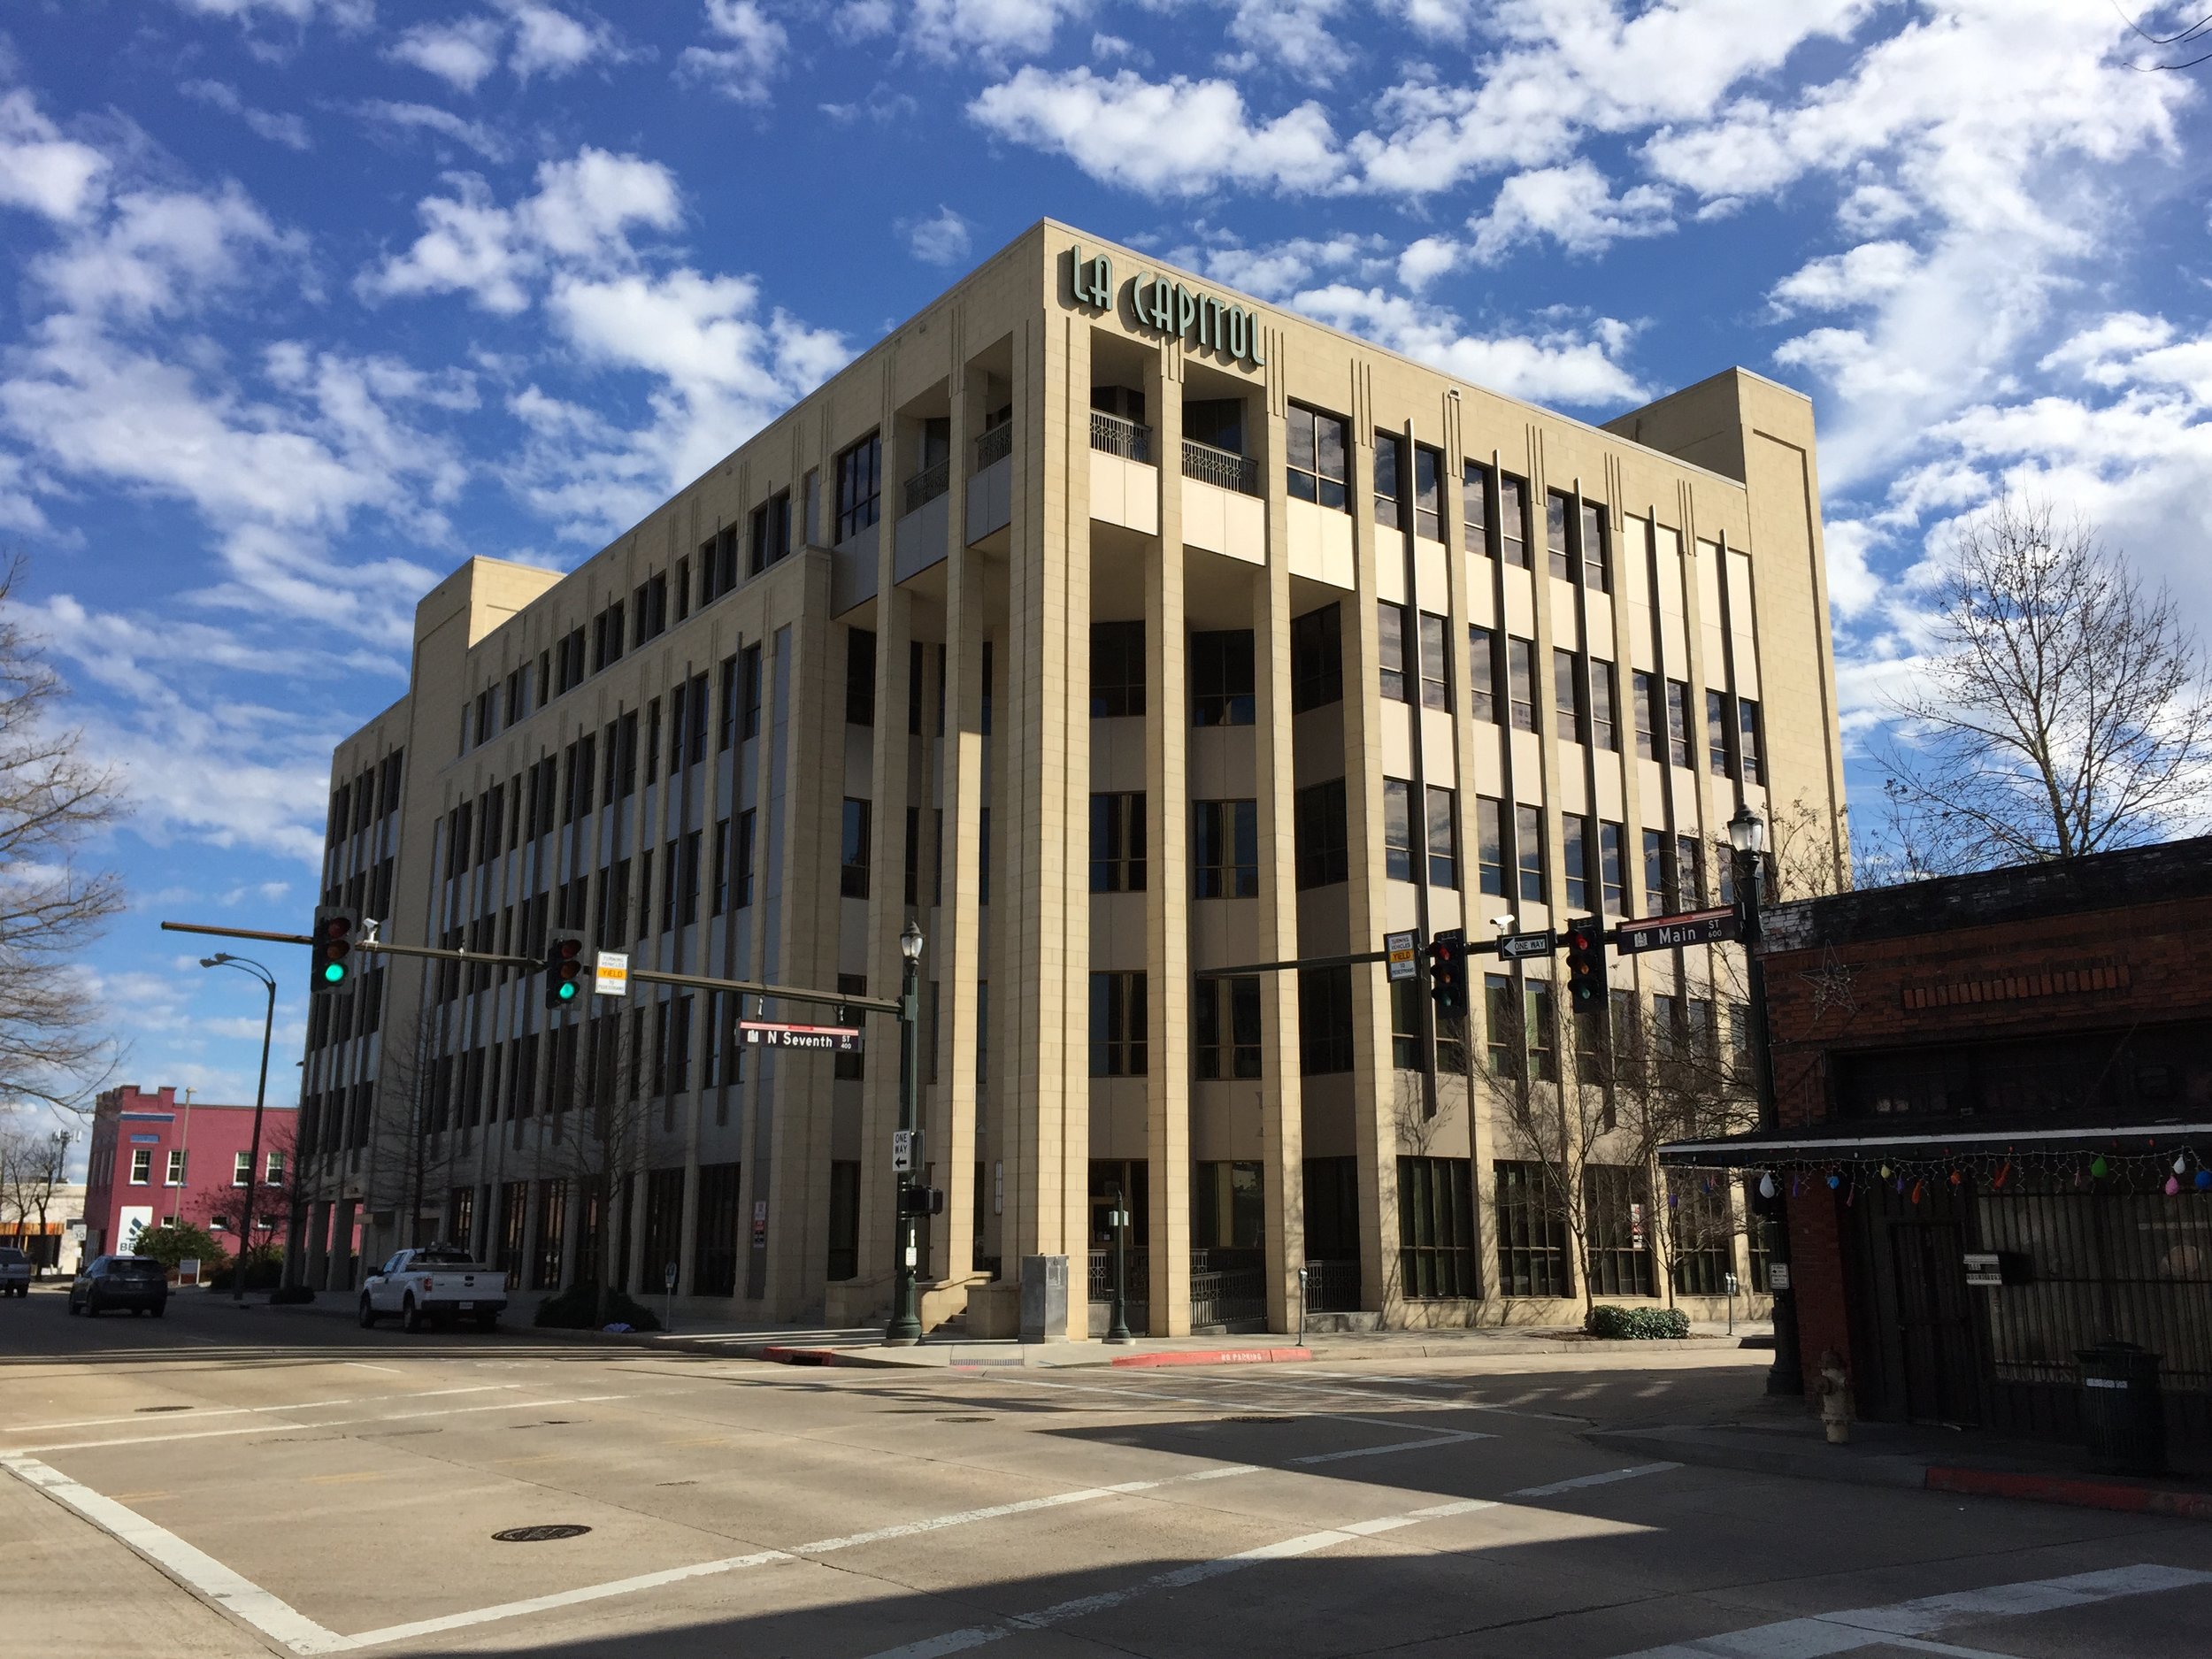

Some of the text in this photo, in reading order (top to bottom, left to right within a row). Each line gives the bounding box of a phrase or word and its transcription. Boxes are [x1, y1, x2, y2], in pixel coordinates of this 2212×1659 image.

[1072, 244, 1265, 366] LA CAPITOL
[1709, 919, 1719, 929] ST
[1658, 927, 1696, 944] Main
[1708, 930, 1722, 939] 600
[1514, 940, 1544, 950] ONE WAY
[1393, 951, 1410, 960] YIELD
[767, 1031, 833, 1048] N Seventh
[895, 1133, 907, 1143] ONE
[895, 1144, 907, 1154] WAY
